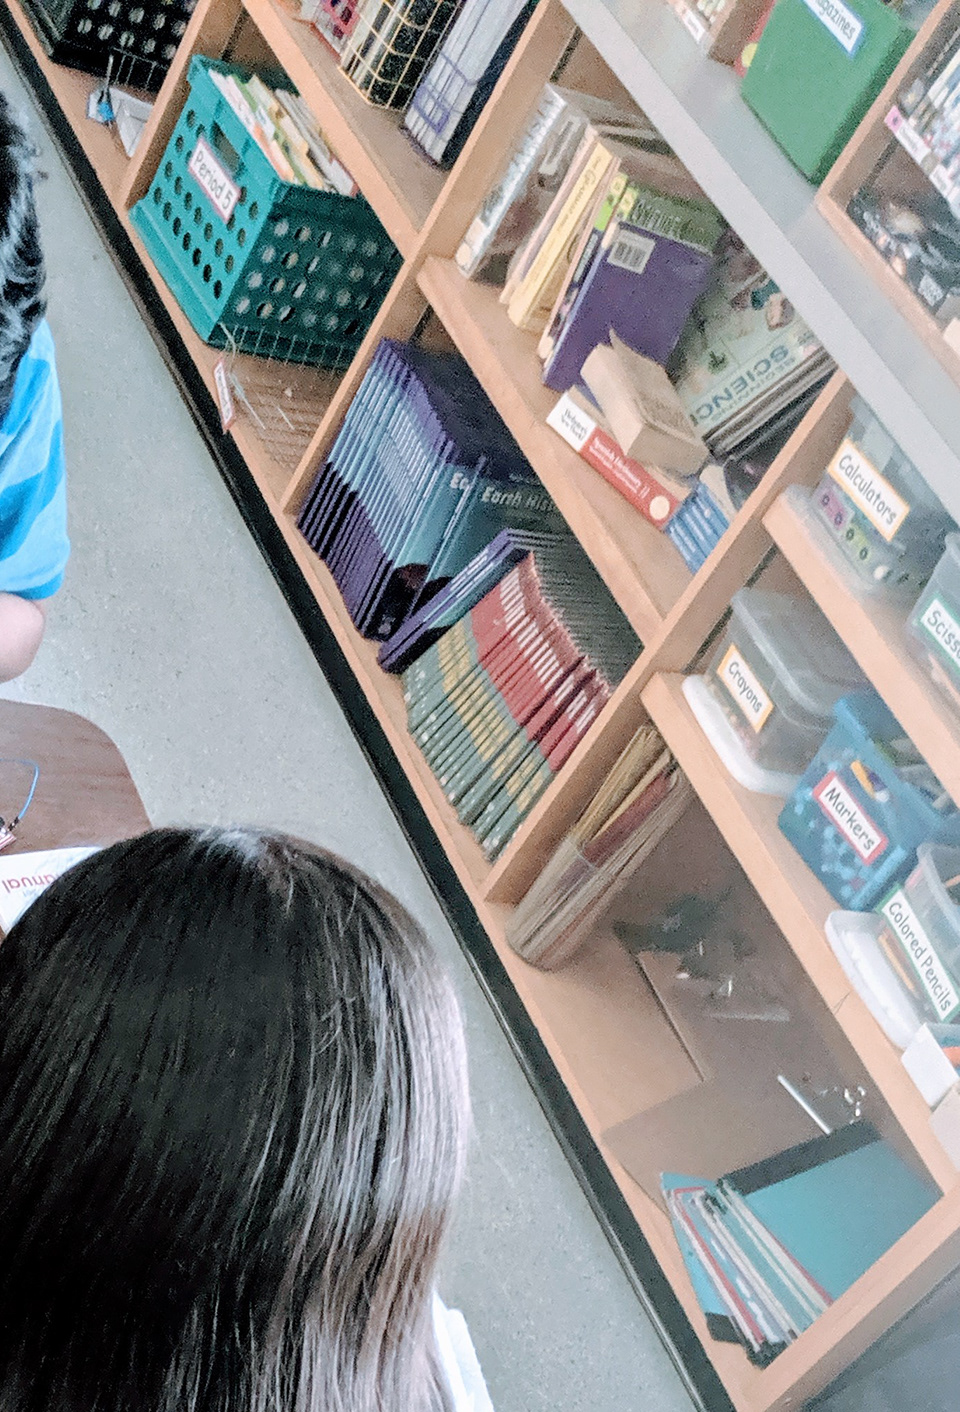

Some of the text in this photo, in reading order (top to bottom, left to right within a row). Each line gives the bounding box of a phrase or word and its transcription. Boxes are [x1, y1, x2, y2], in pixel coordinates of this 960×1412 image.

[194, 150, 233, 209] Period 5
[690, 345, 789, 427] SCIENC
[839, 454, 897, 525] Calculators
[728, 661, 762, 713] Crayons
[825, 787, 875, 851] Markers
[2, 874, 59, 893] anual
[889, 902, 951, 1011] Colored Pencils
